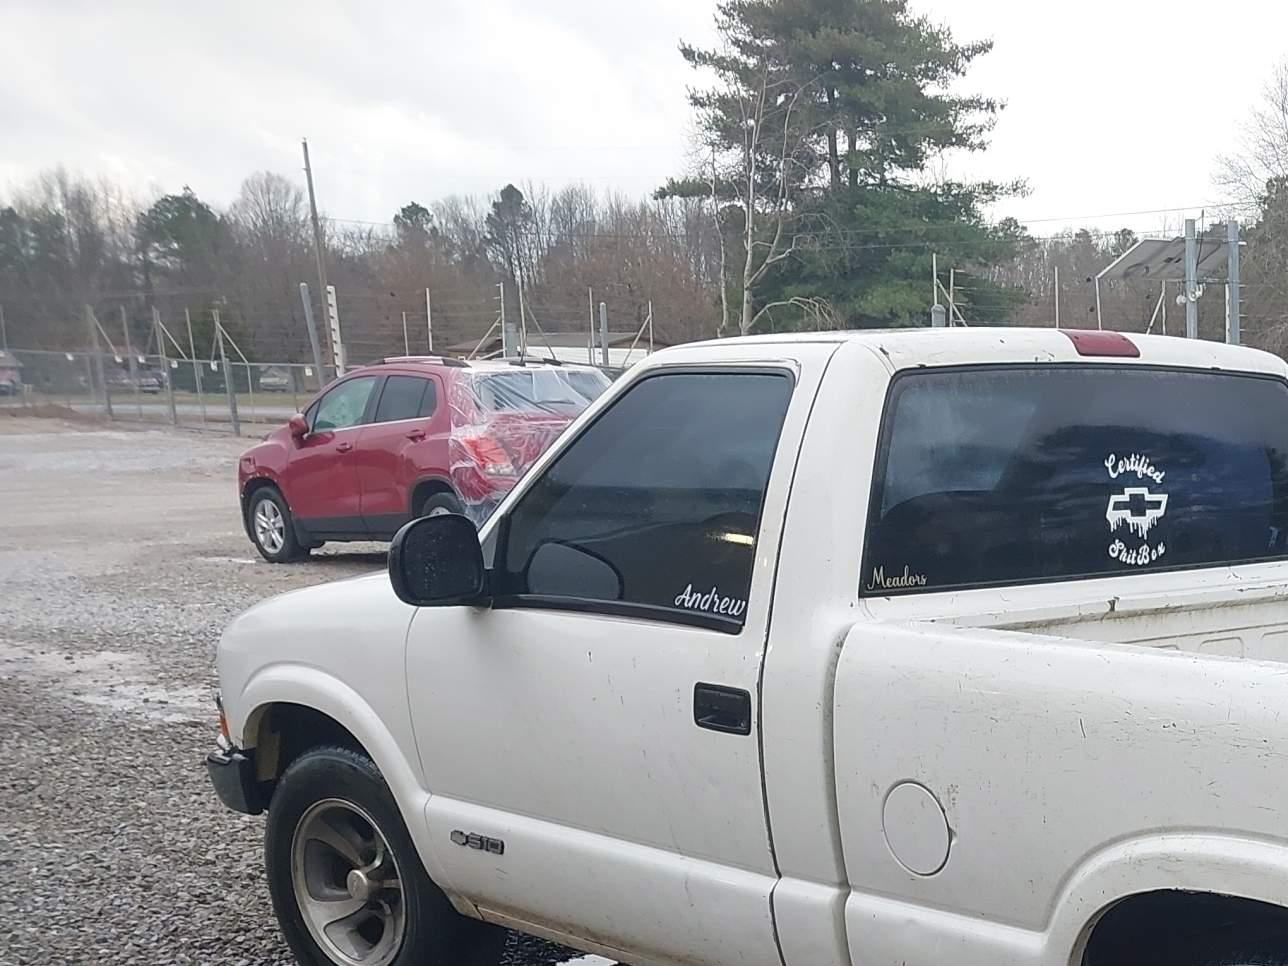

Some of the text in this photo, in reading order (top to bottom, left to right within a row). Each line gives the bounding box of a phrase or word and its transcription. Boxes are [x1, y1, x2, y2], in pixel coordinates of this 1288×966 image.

[1104, 453, 1165, 484] Certified
[1108, 539, 1166, 566] ShitBox
[867, 564, 928, 590] Meadors
[674, 583, 746, 616] Andrew
